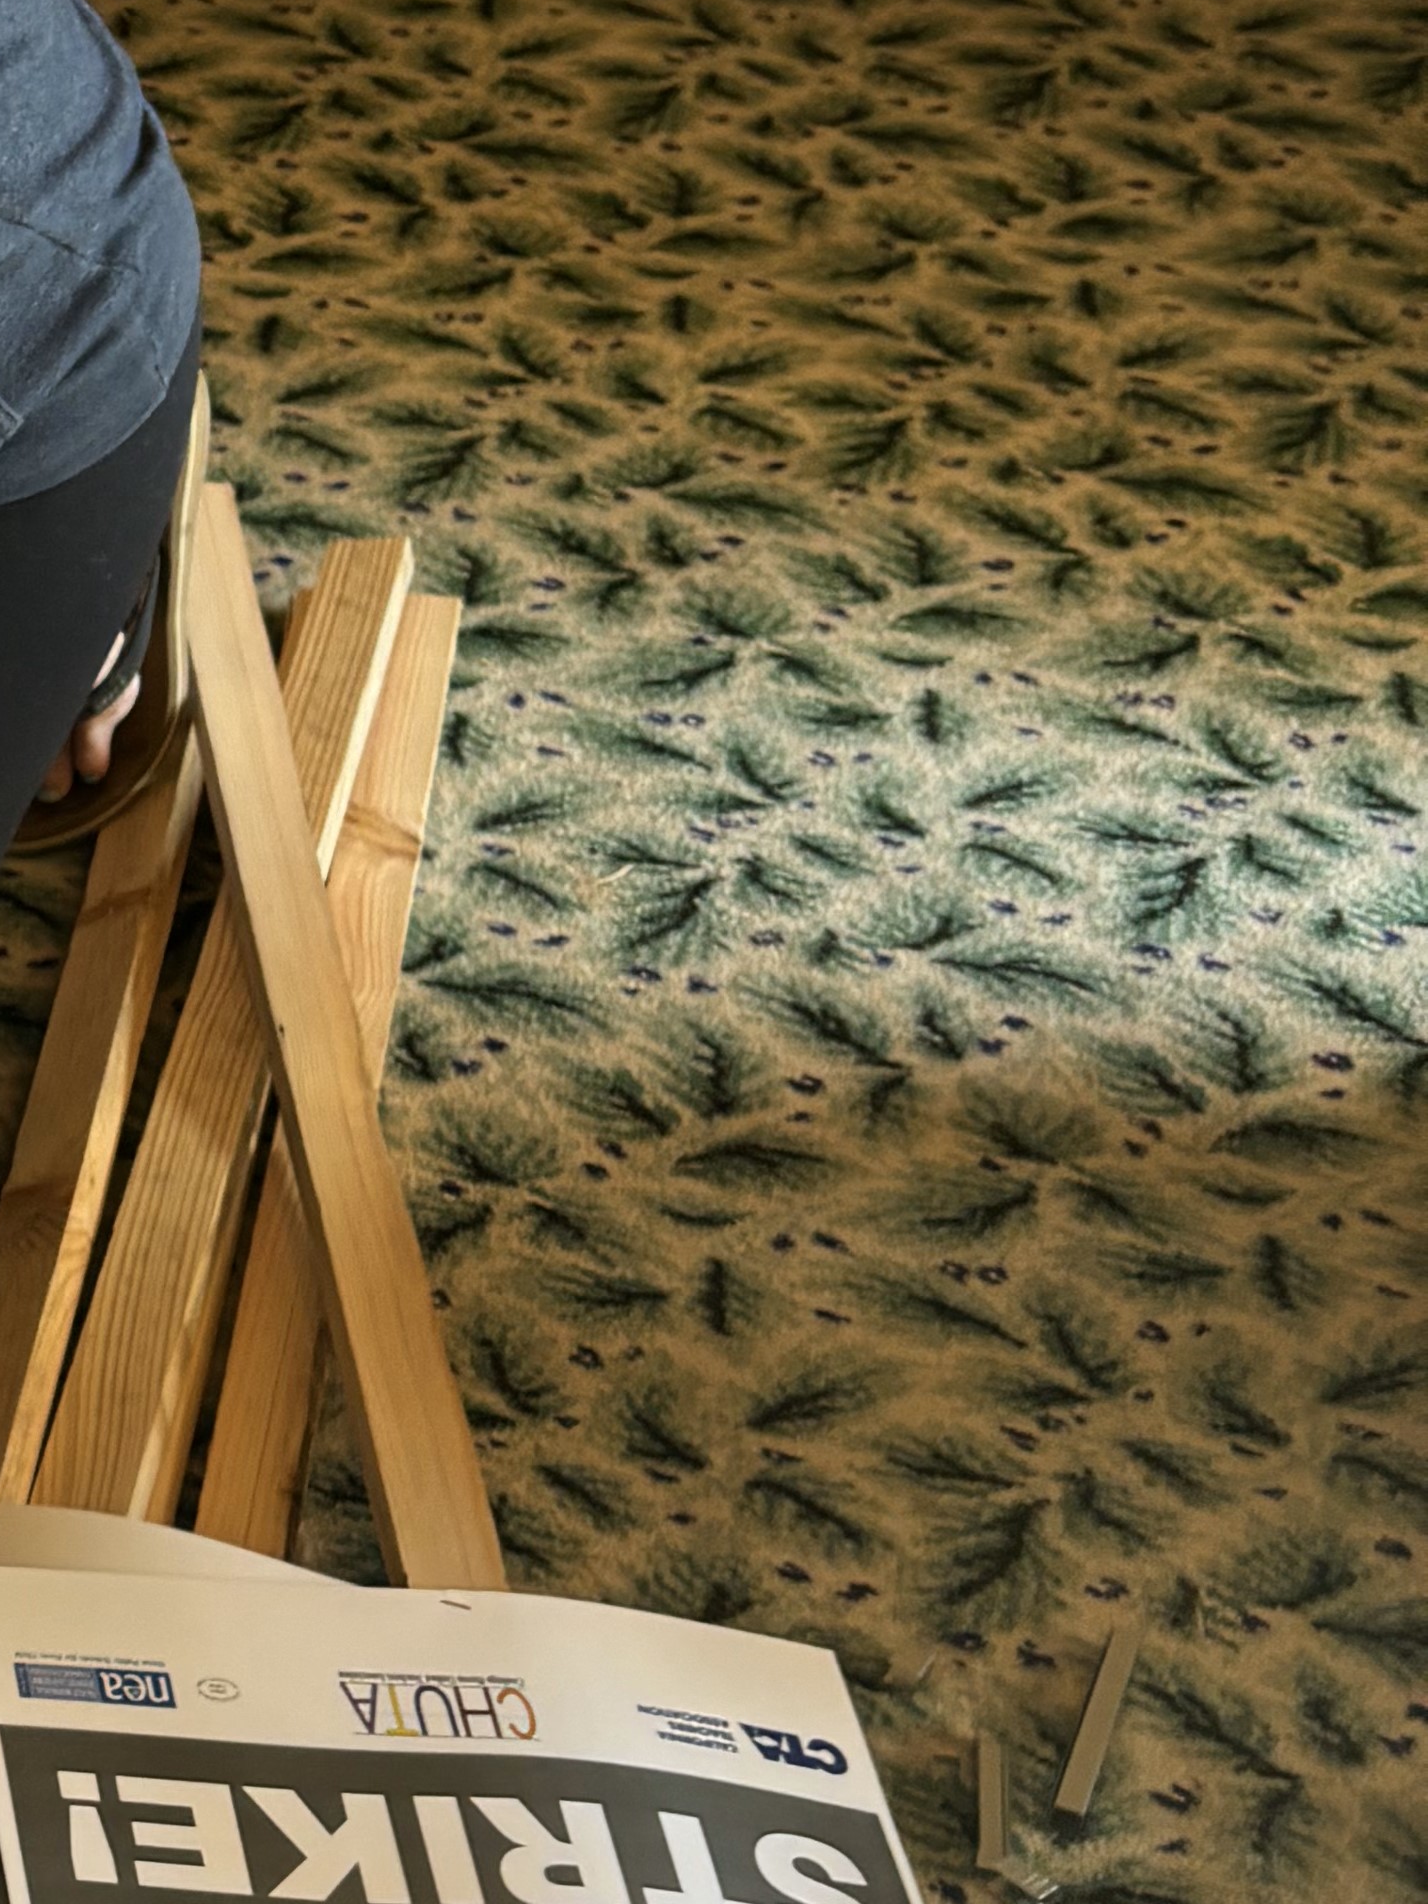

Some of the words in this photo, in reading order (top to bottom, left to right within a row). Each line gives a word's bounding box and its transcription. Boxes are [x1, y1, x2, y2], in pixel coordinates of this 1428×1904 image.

[99, 1671, 170, 1704] nea
[339, 1681, 536, 1741] CHUTA
[738, 1723, 848, 1775] CTA
